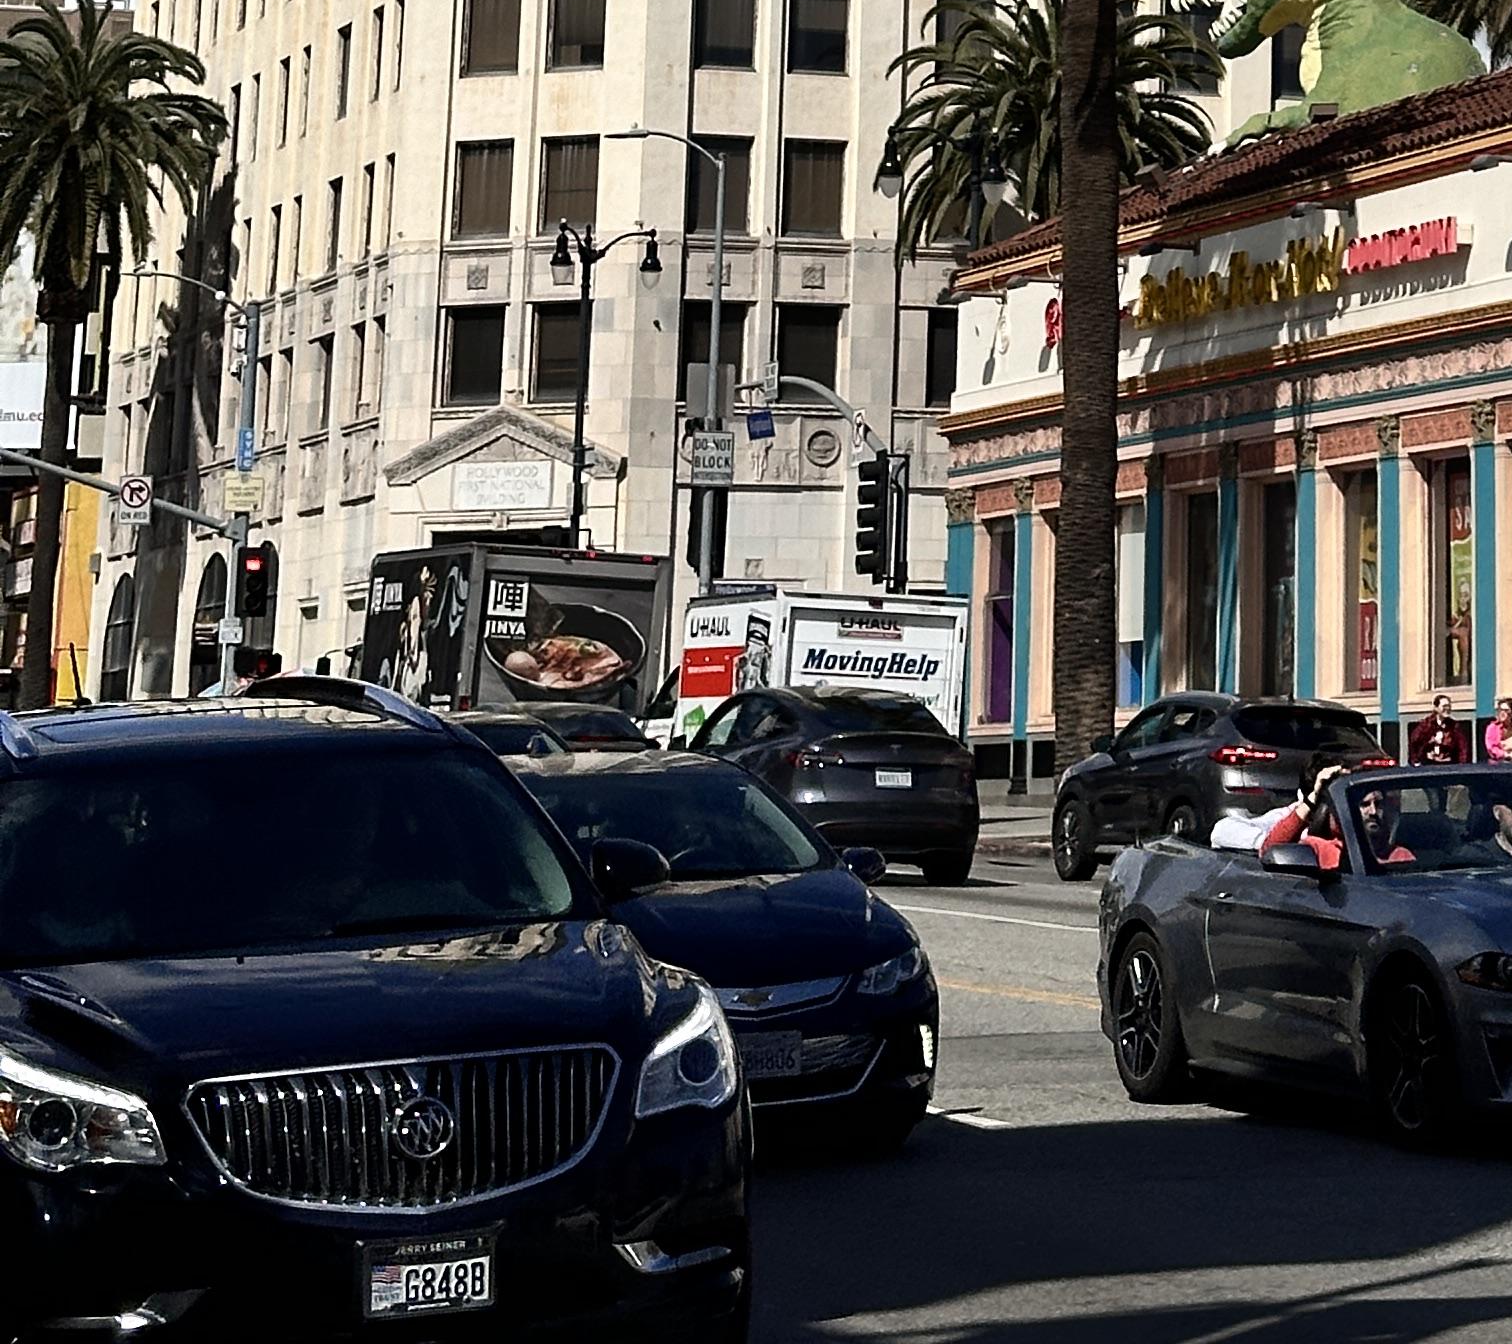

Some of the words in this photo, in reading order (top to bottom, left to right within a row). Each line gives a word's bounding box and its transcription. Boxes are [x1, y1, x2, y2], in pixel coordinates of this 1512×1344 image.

[694, 455, 731, 469] BLOCK
[484, 620, 526, 639] JINYA
[841, 617, 901, 631] U-HAUL
[803, 648, 940, 680] MovingHelp
